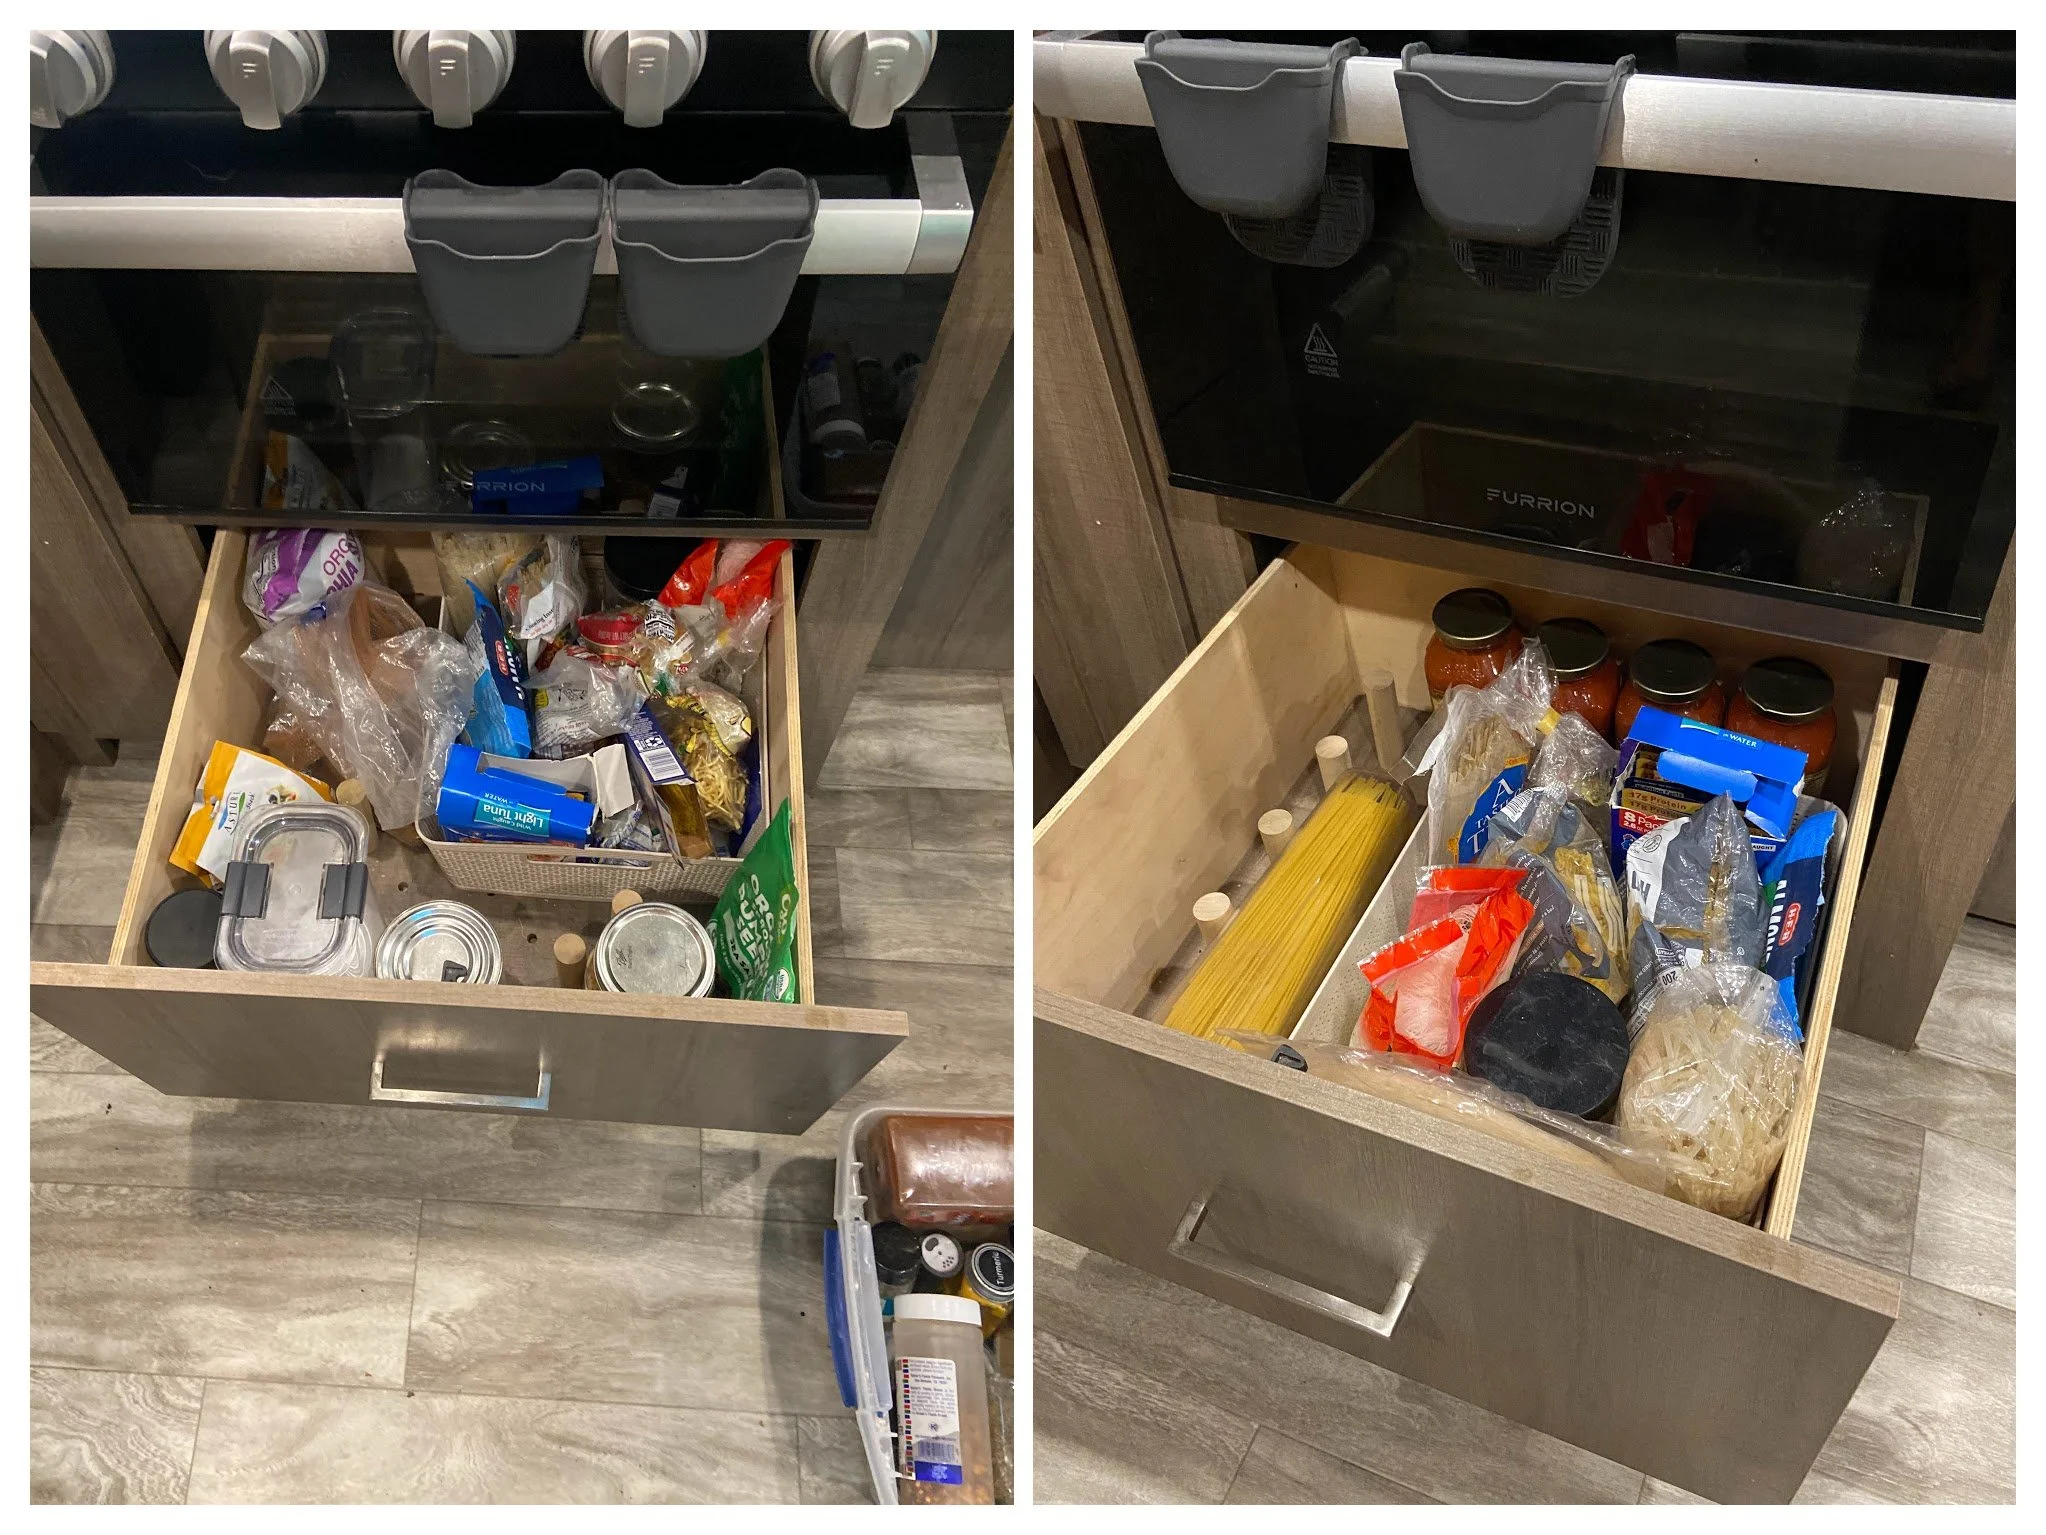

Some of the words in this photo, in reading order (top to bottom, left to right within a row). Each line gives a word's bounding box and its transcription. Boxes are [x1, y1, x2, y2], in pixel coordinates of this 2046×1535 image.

[1486, 487, 1595, 519] FURRION
[1729, 733, 1758, 748] WATER
[484, 792, 508, 804] WATER
[1650, 795, 1687, 810] Protein
[483, 803, 512, 820] Tuna
[515, 811, 544, 828] Light
[1624, 811, 1636, 823] 8
[994, 1251, 1005, 1286] Turmeric
